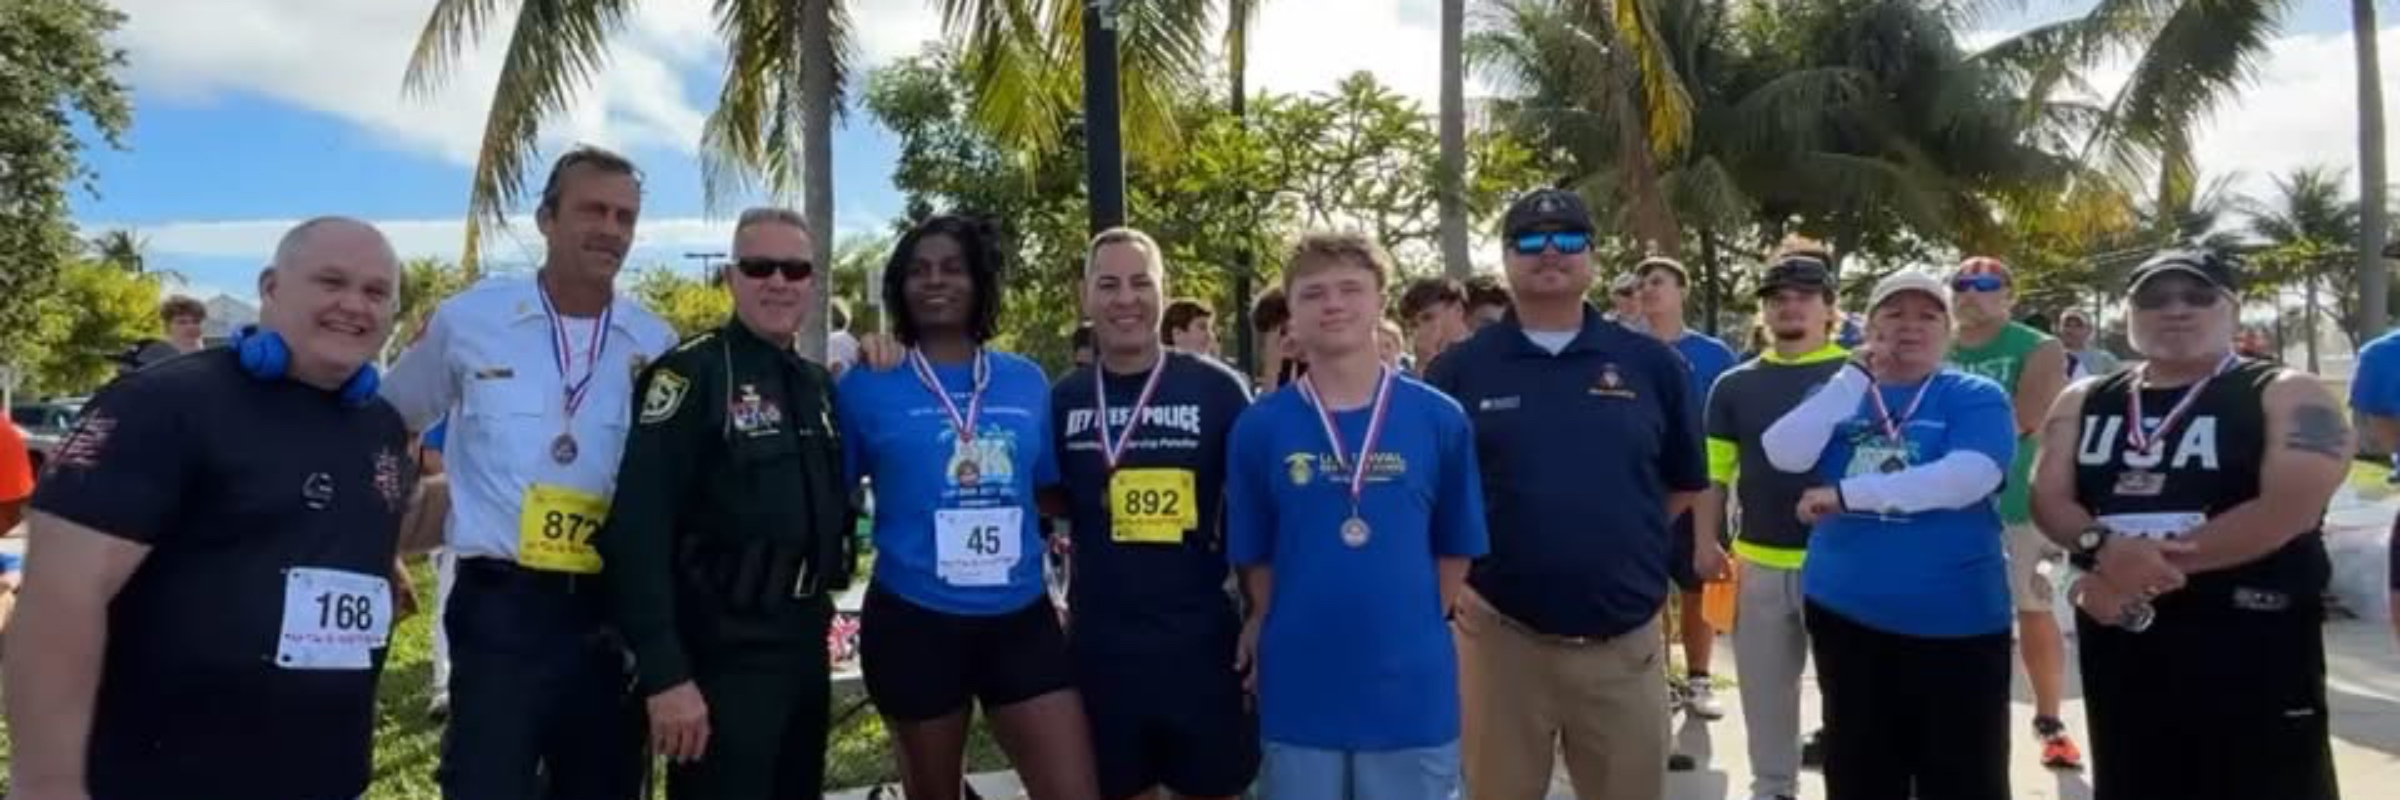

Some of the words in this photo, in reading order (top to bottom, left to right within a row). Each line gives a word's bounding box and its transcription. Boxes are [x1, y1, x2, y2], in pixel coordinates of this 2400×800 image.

[1141, 404, 1200, 435] POLICE
[2079, 415, 2218, 468] USA
[1125, 489, 1179, 515] 892
[543, 510, 600, 546] 872
[966, 526, 1001, 555] 45
[315, 592, 373, 630] 168
